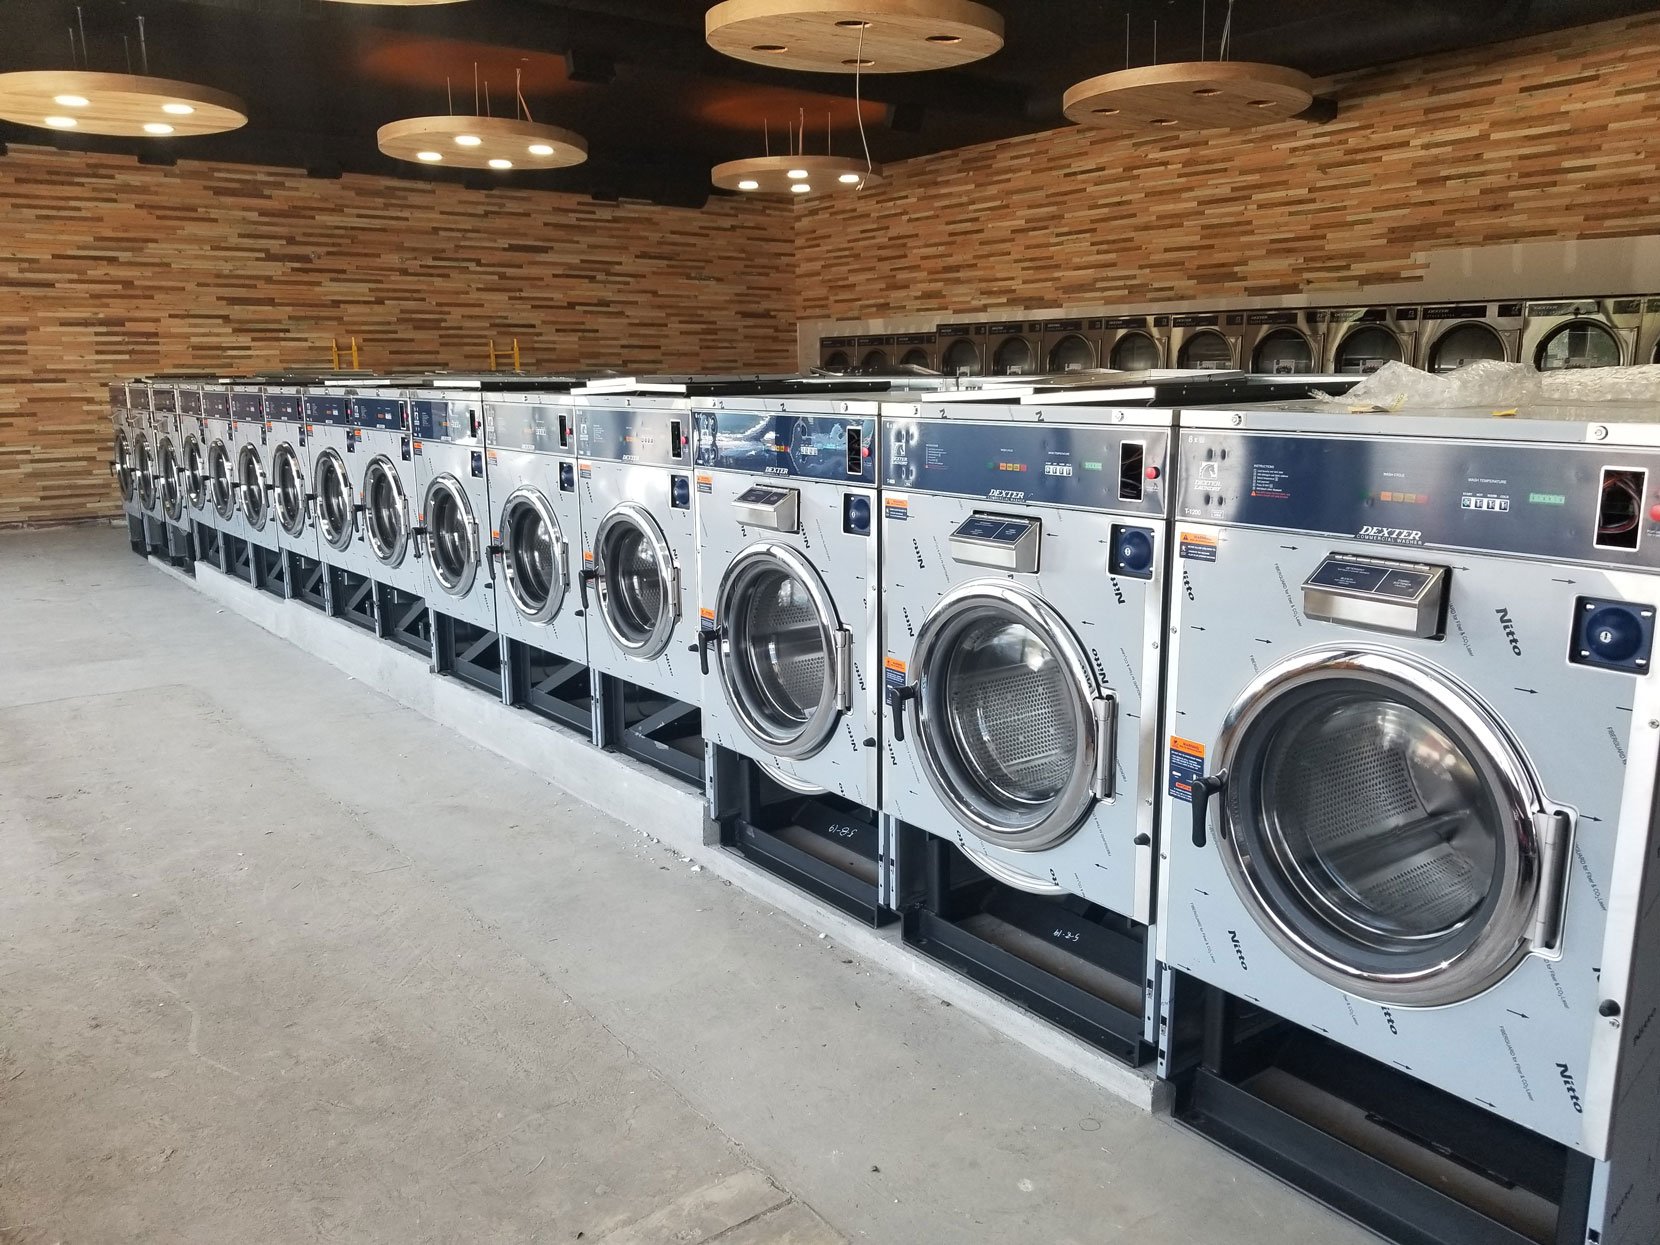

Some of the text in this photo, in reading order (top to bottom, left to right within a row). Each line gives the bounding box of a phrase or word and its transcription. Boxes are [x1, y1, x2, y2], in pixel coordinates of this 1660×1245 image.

[988, 488, 1025, 499] DEXTER
[1184, 507, 1202, 516] T-1200
[1356, 534, 1395, 544] COMMERCIAL
[1358, 525, 1422, 540] DEXTER
[912, 538, 925, 569] Nitto
[1495, 607, 1522, 656] Nitto
[854, 662, 866, 691] Nitto
[1092, 648, 1109, 684] Nitto
[847, 723, 858, 752] Nitto
[1607, 726, 1625, 760] FIBERGUARD
[1585, 871, 1594, 883] Fiber
[1597, 898, 1607, 911] Laser
[1228, 930, 1248, 971] Nitto
[1381, 1006, 1398, 1035] itto
[1499, 1025, 1515, 1056] FIBERGUARD
[1515, 1063, 1523, 1074] Fiber
[1556, 1062, 1583, 1114] Nitto
